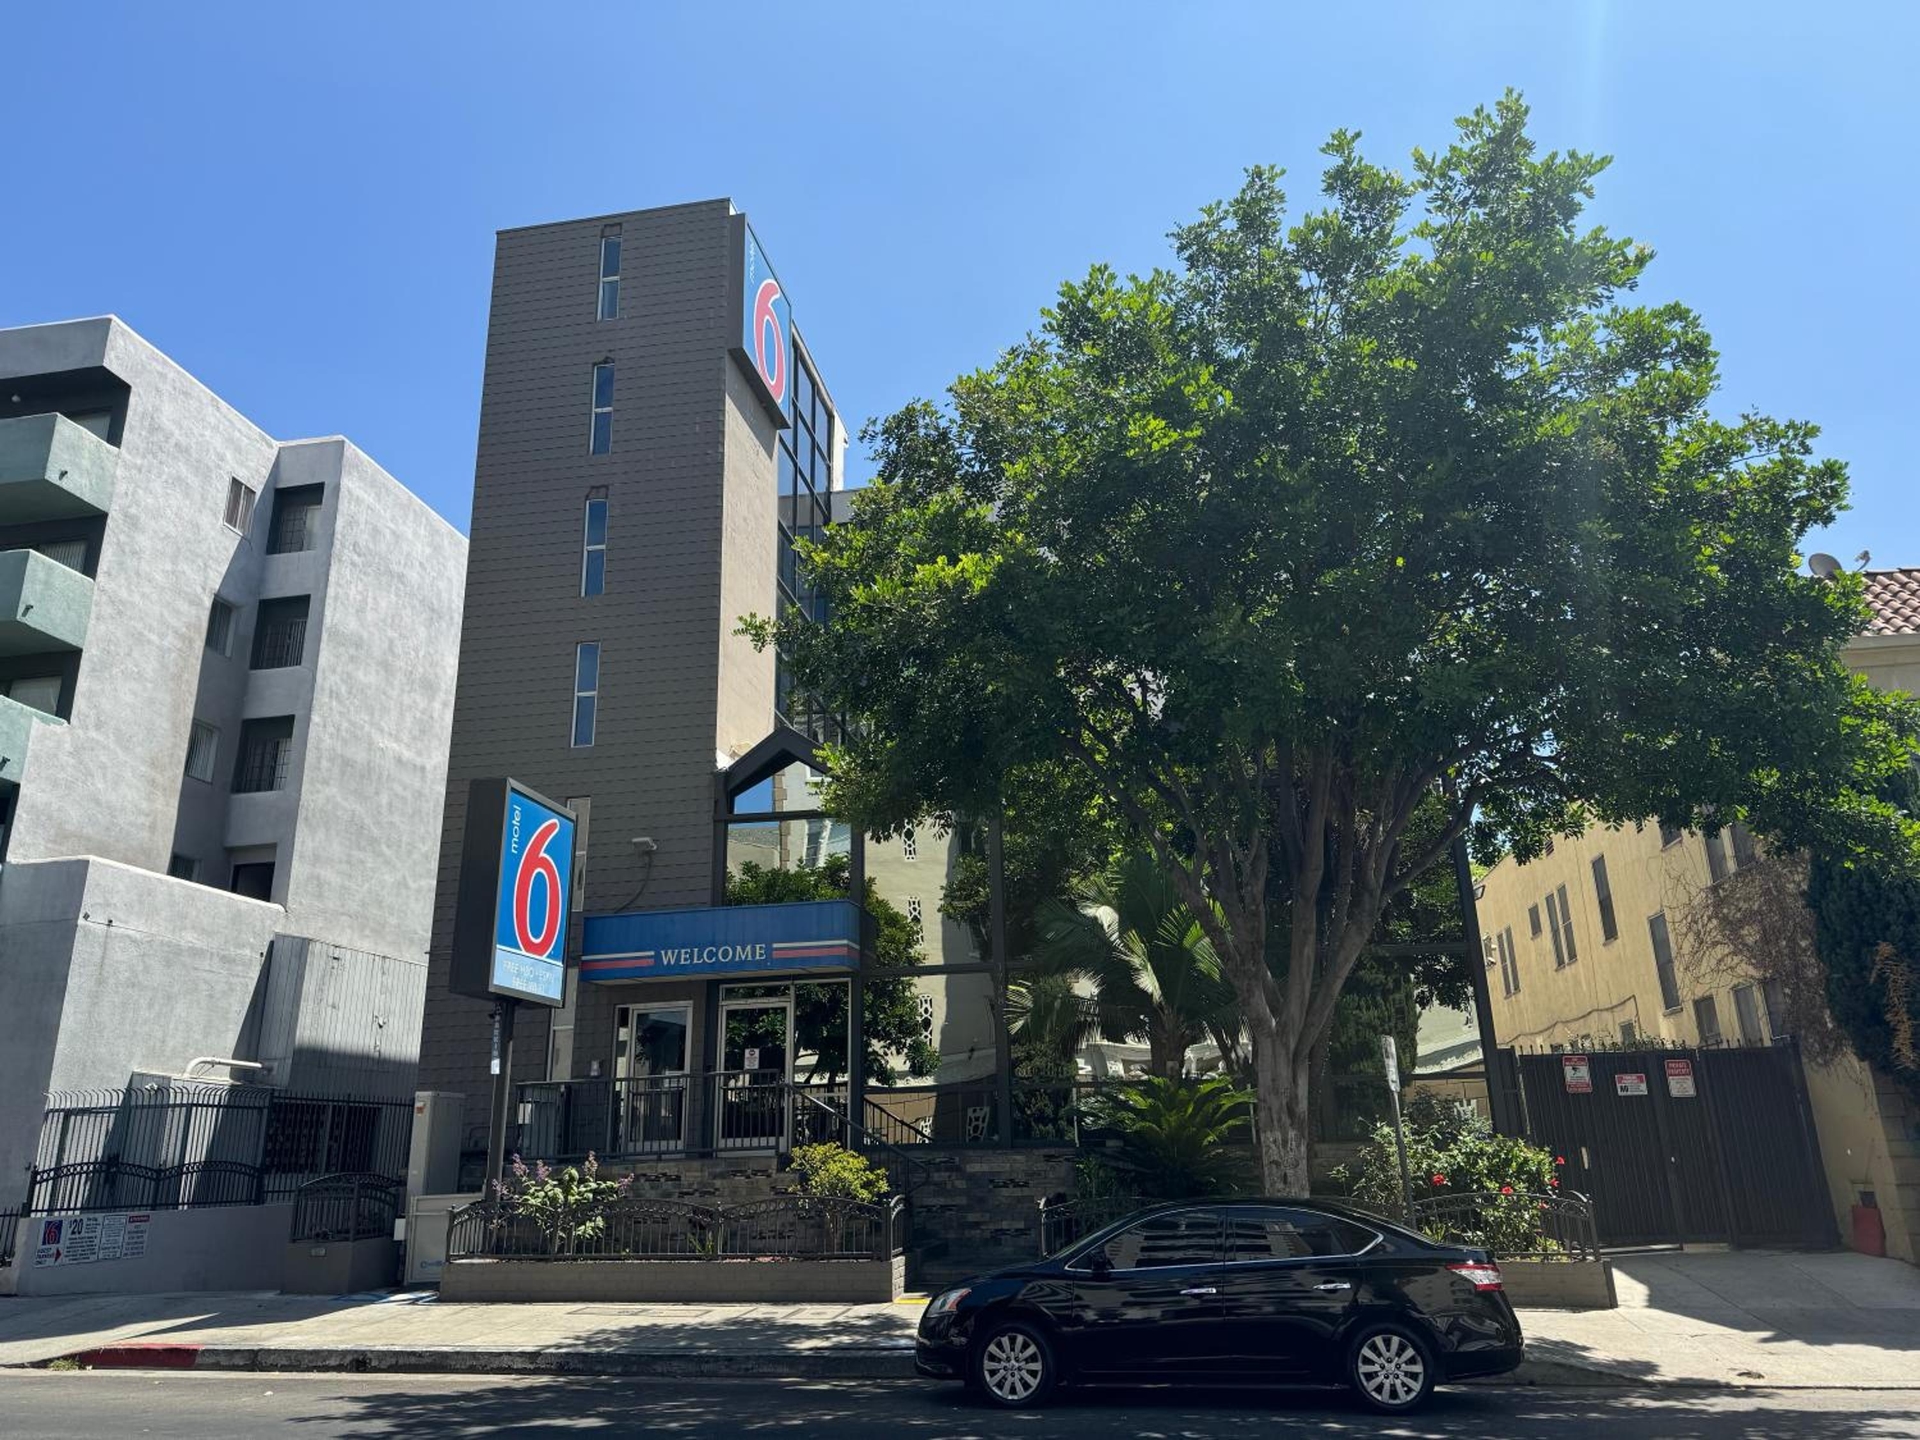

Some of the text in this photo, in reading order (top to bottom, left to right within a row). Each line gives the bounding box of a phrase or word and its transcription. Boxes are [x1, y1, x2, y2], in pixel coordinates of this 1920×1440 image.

[754, 278, 786, 404] 6
[511, 804, 521, 854] motel
[513, 818, 562, 958] 6
[660, 943, 767, 966] WELCOME
